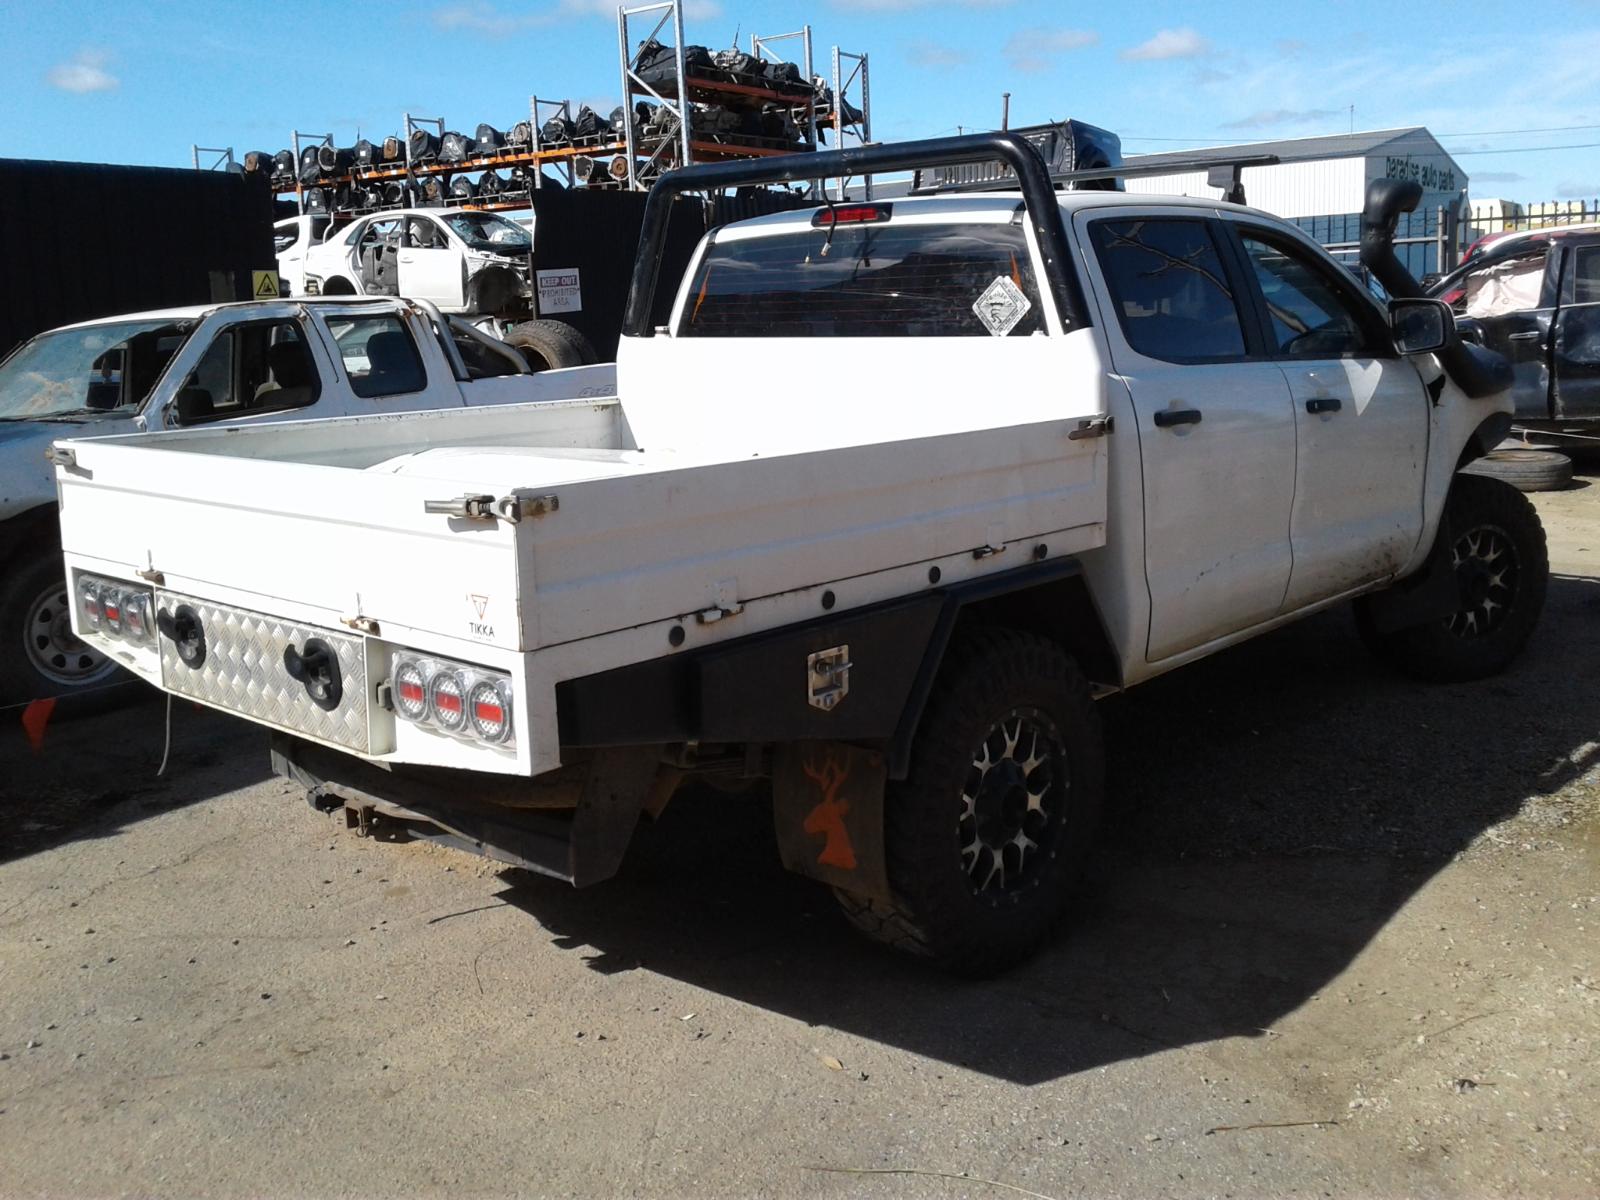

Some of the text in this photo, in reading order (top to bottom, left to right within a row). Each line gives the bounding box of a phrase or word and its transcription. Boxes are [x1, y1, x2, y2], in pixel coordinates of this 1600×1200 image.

[1422, 163, 1438, 188] auto
[1439, 169, 1455, 191] parts
[542, 276, 576, 287] KEEP OUT
[469, 622, 495, 638] TIKKA
